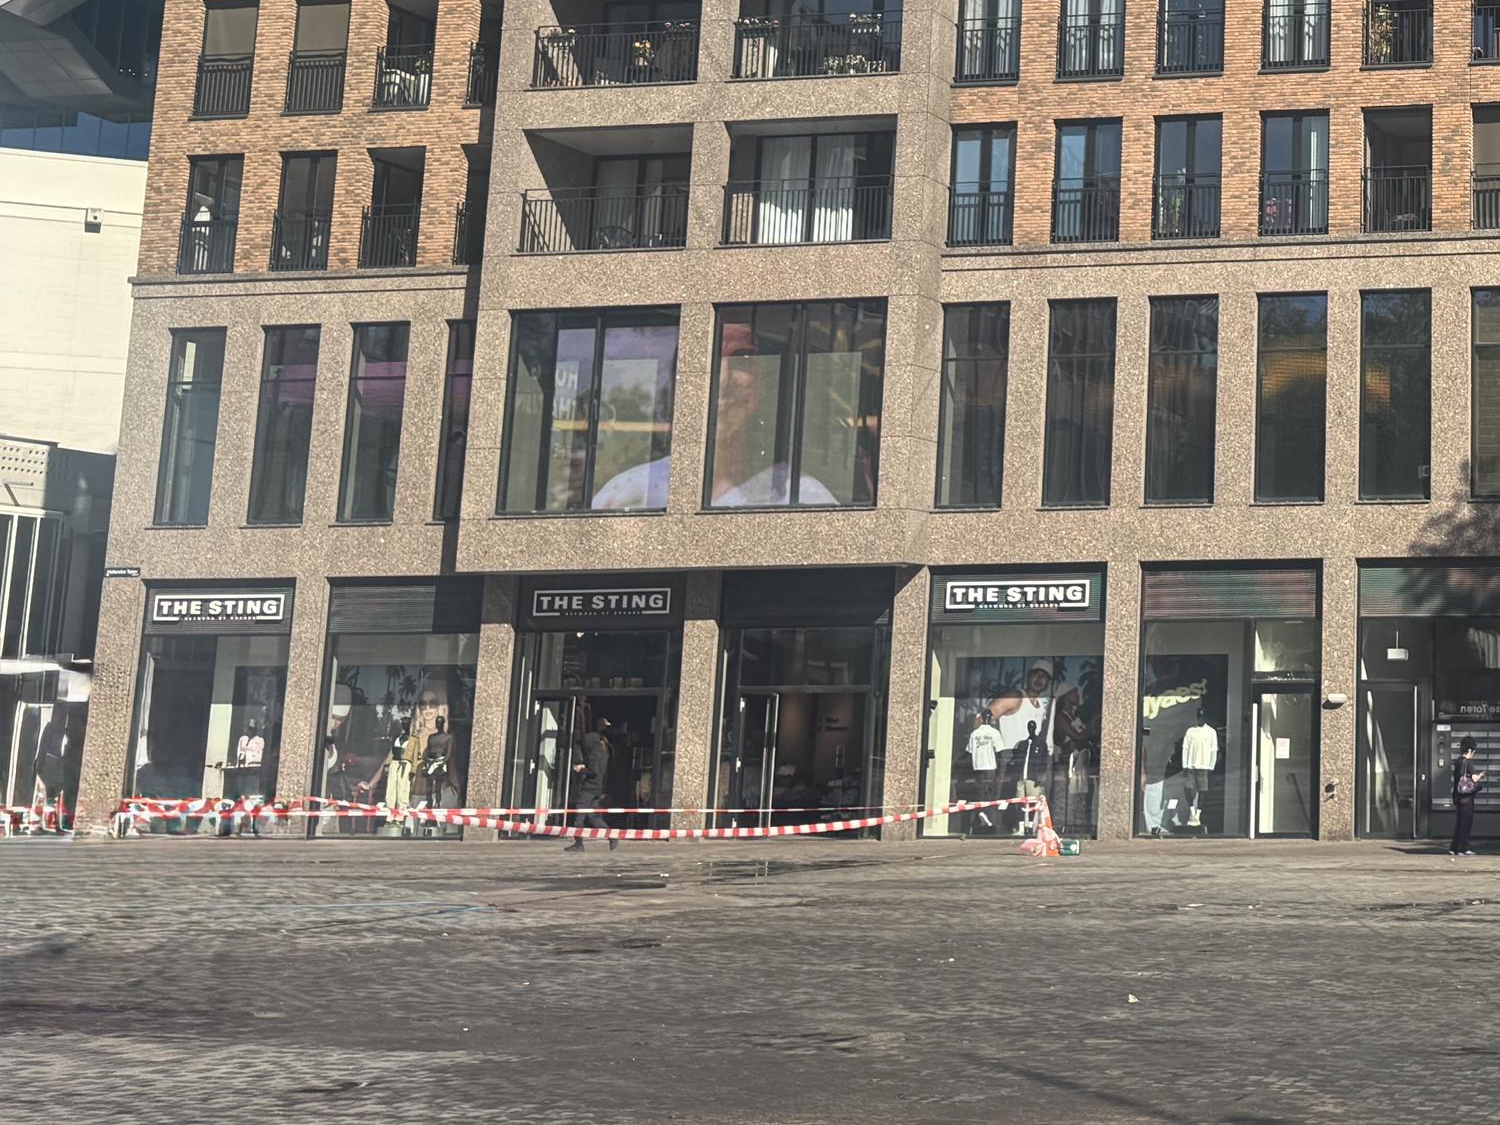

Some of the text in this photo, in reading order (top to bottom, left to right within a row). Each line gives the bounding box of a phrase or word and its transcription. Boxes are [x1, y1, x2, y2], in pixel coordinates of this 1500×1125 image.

[540, 593, 665, 610] THE STING
[953, 585, 1084, 603] THE STING
[160, 599, 278, 615] THE STING
